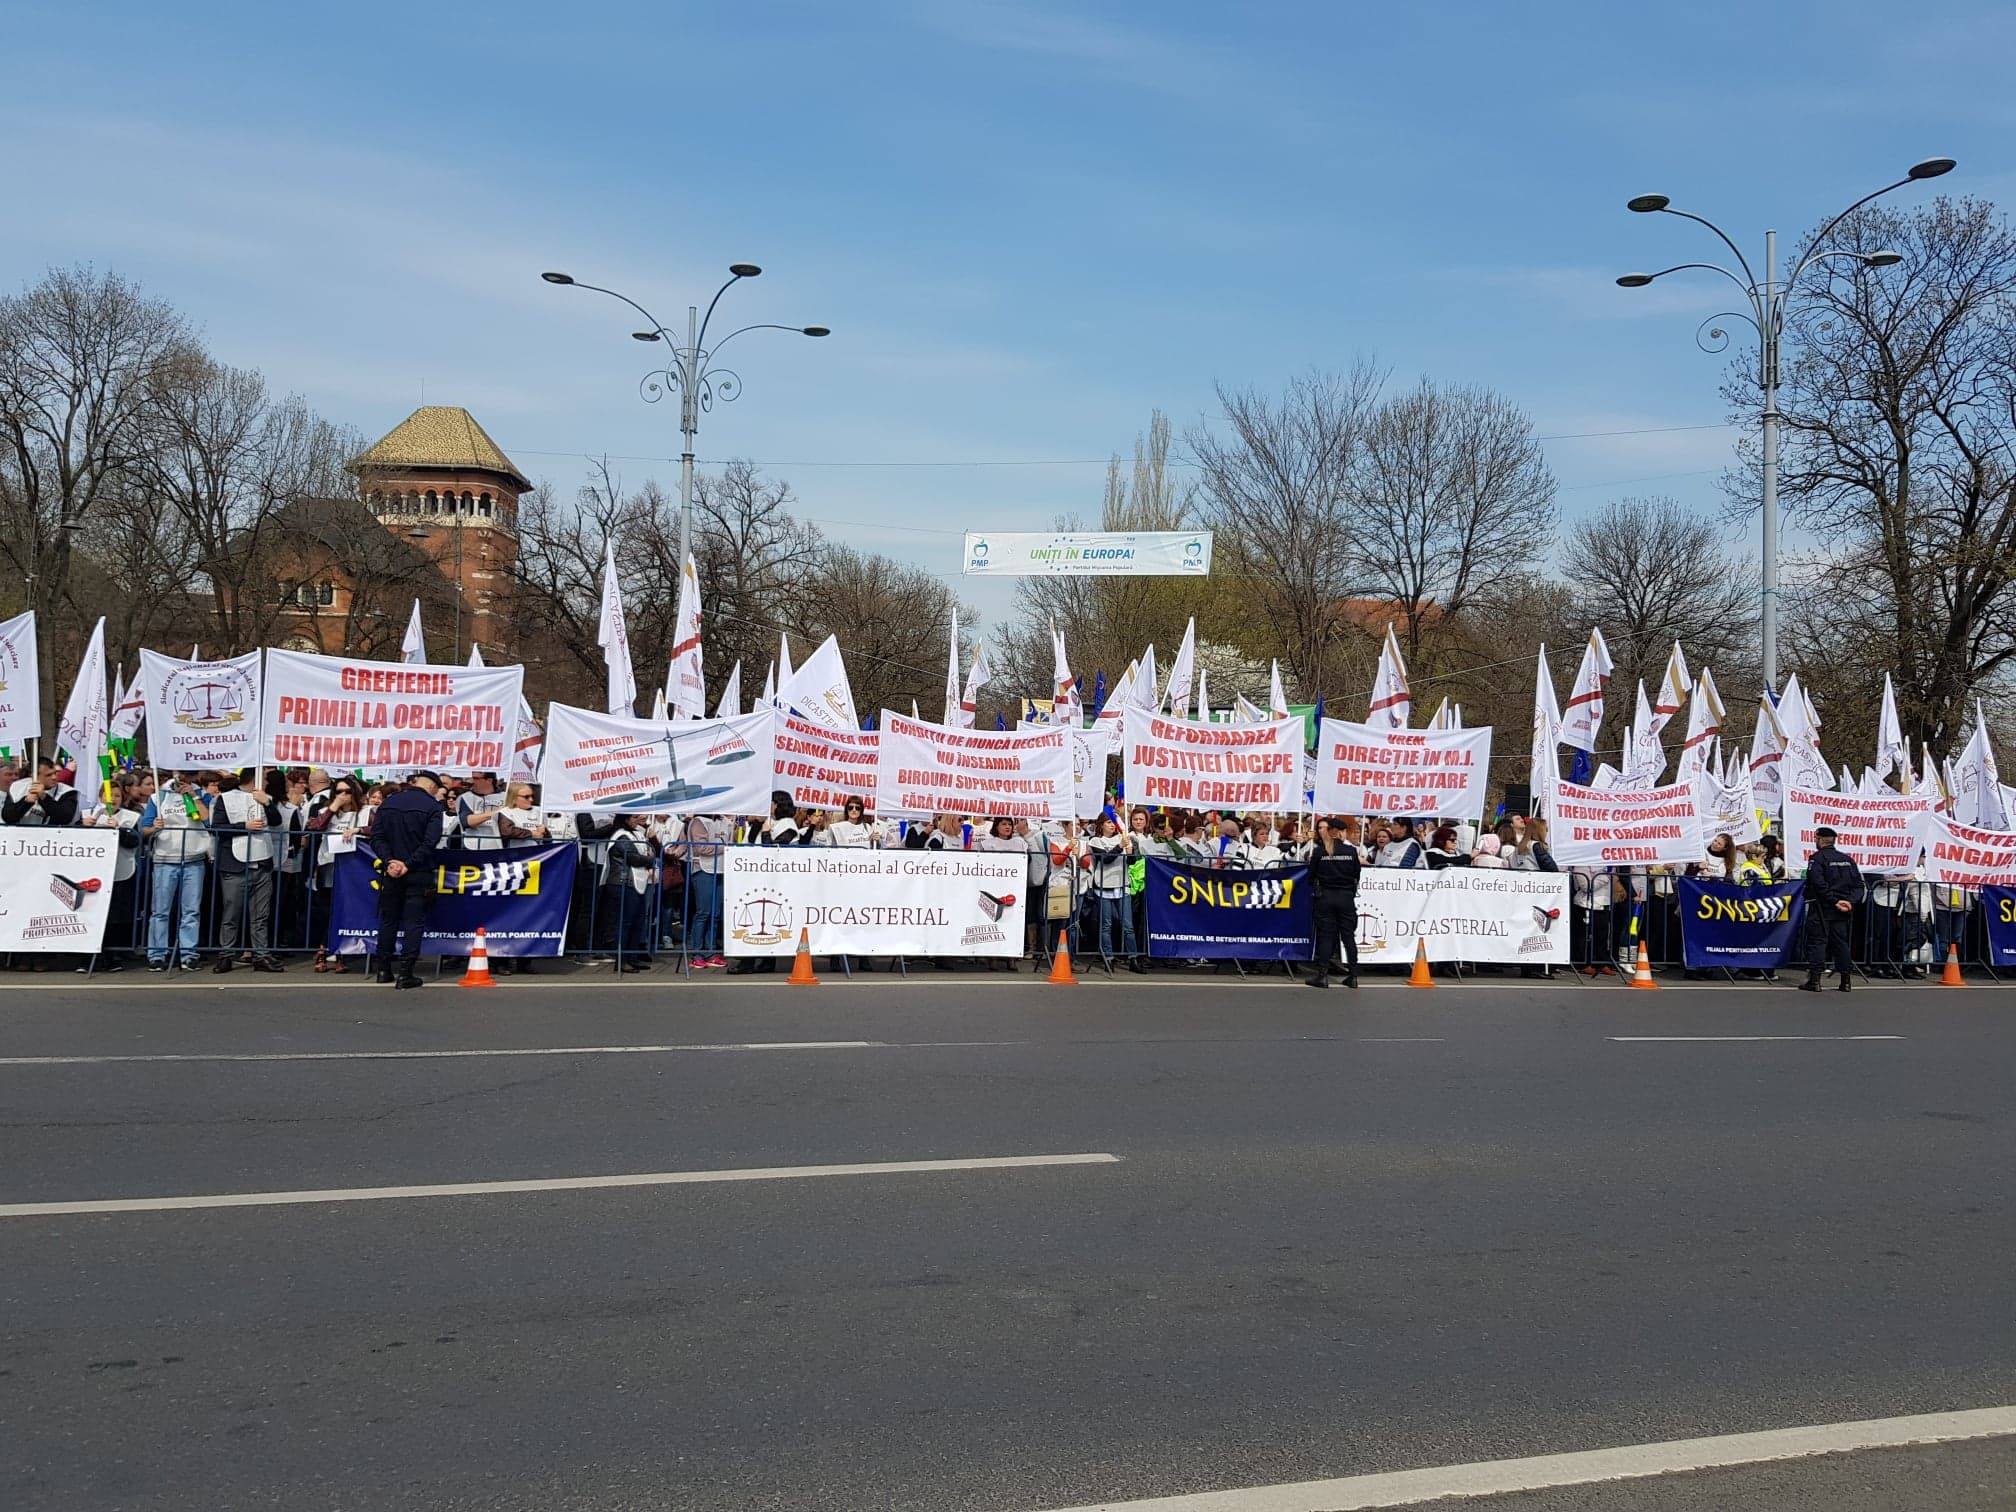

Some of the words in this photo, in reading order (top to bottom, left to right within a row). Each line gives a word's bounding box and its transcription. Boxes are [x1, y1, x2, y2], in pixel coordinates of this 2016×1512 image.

[971, 559, 989, 567] PMP
[1082, 549, 1135, 560] EUROPA!
[1183, 559, 1202, 567] PMP
[341, 667, 454, 695] GREFIERII:
[278, 696, 356, 728] PRIMII
[362, 702, 388, 729] LA
[393, 703, 504, 738] OBLIGAȚII,
[172, 734, 248, 745] DICASTERIAL
[947, 735, 964, 748] DE
[1012, 733, 1063, 749] DECENTE
[1151, 719, 1277, 746] REFORMAREA
[185, 751, 237, 761] Prahova
[274, 735, 360, 764] ULTIMII
[366, 739, 391, 765] LA
[397, 739, 504, 768] DREPTURI
[708, 738, 746, 757] DREPTURI
[774, 734, 828, 759] SEAMNĂ
[936, 751, 954, 765] NU
[956, 752, 1021, 771] ÎNSEAMNĂ
[1133, 745, 1221, 776] JUSTIȚIEI
[1226, 751, 1293, 774] ÎNCEPE
[1333, 744, 1418, 769] DIRECȚIE
[1424, 750, 1442, 766] ÎN
[774, 759, 785, 774] U
[787, 762, 815, 778] ORE
[897, 768, 952, 787] BIROURI
[955, 776, 1055, 794] SUPRAPOPULATE
[1336, 768, 1468, 789] REPREZENTARE
[795, 786, 829, 805] FĂRĂ
[1146, 777, 1192, 800] PRIN
[1197, 781, 1280, 803] GREFIERI
[902, 791, 934, 809] FĂRĂ
[936, 796, 987, 815] LUMINĂ
[988, 799, 1050, 818] NATURALĂ
[1362, 792, 1383, 809] ÎN
[1387, 794, 1439, 811] C.S.M.
[1556, 804, 1608, 821] TREBUIE
[1813, 812, 1873, 828] PING-PONG
[1875, 815, 1907, 829] ÎNTRE
[1574, 827, 1589, 841] DE
[1593, 828, 1611, 840] UN
[1614, 825, 1682, 840] ORGANISM
[1800, 830, 1865, 847] MIERUL
[1866, 835, 1906, 848] MUNCII
[1947, 823, 2016, 847] SUNTE
[13, 840, 105, 858] Judiciare
[1601, 847, 1659, 861] CENTRAL
[733, 858, 812, 873] Sindicatul
[816, 860, 881, 877] Național
[886, 861, 899, 875] al
[903, 861, 948, 876] Grefei
[952, 861, 1018, 878] Judiciare
[1169, 875, 1249, 908] SNLP
[1457, 877, 1468, 889] al
[1472, 877, 1508, 892] Grefei
[1511, 880, 1562, 894] Judiciare
[804, 906, 949, 926] DICASTERIAL
[1697, 894, 1759, 922] SNLP
[30, 916, 79, 927] IDENTITATE
[1395, 918, 1509, 937] DICASTERIAL
[1150, 933, 1175, 941] FILIALA
[1176, 934, 1205, 942] CENTRUL
